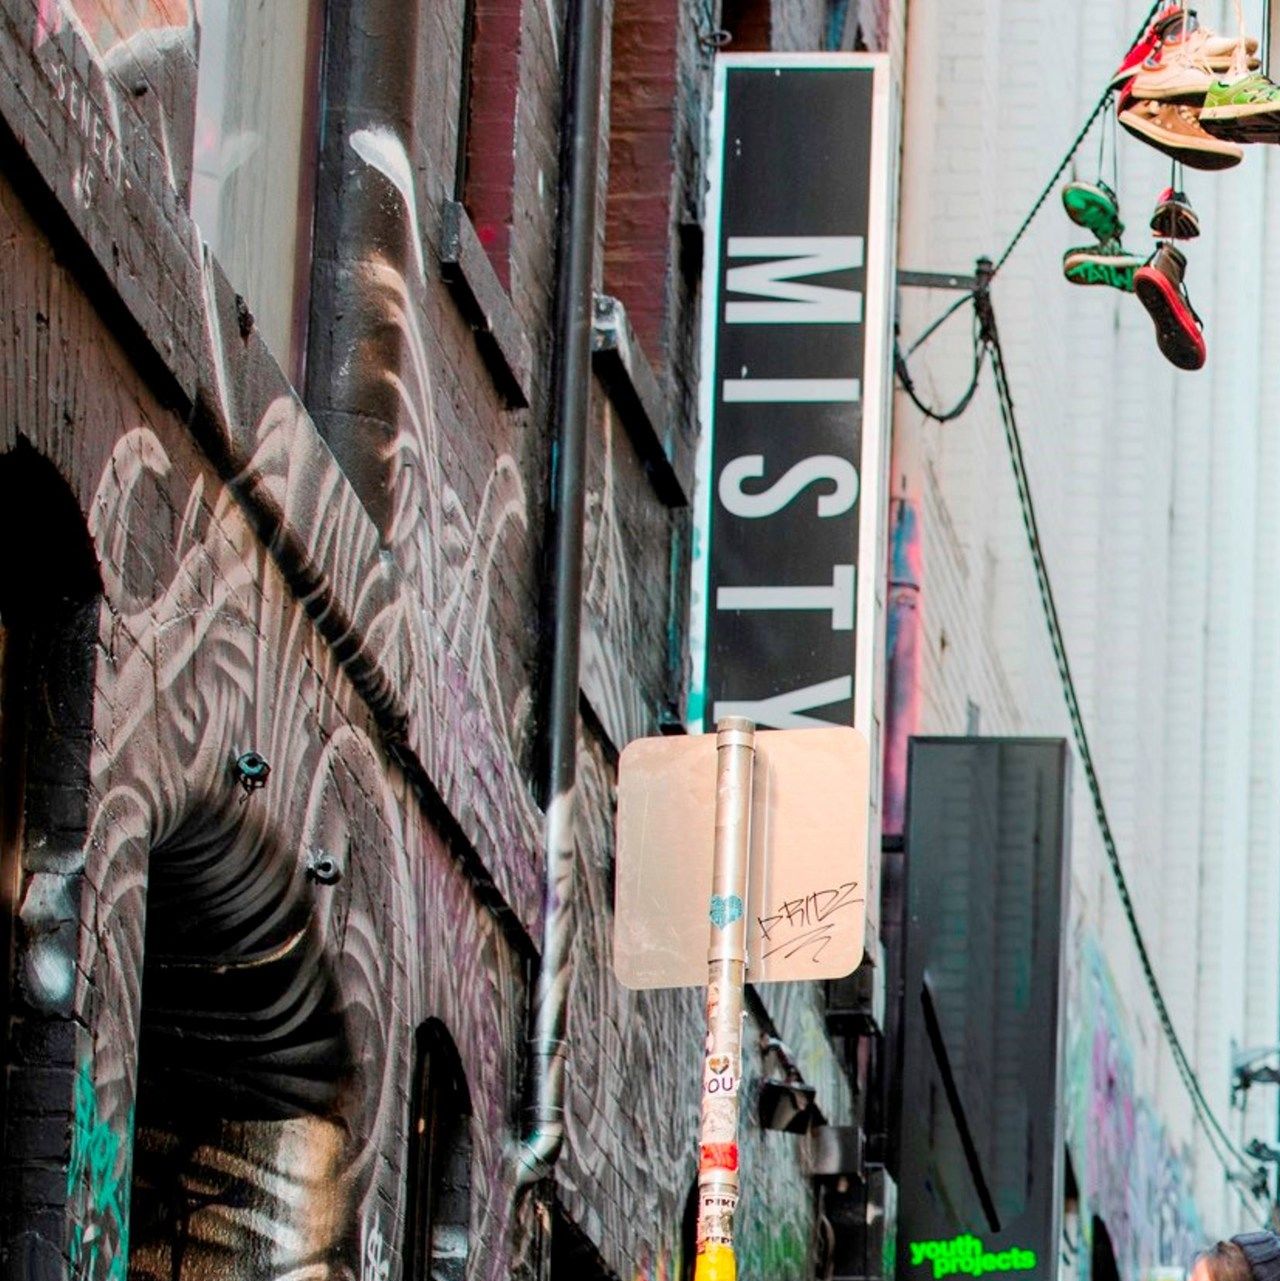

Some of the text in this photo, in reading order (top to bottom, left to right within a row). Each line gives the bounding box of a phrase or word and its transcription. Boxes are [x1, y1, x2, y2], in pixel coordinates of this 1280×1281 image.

[713, 235, 864, 730] MISTY
[910, 1233, 983, 1265] youth
[933, 1246, 1037, 1280] projects
